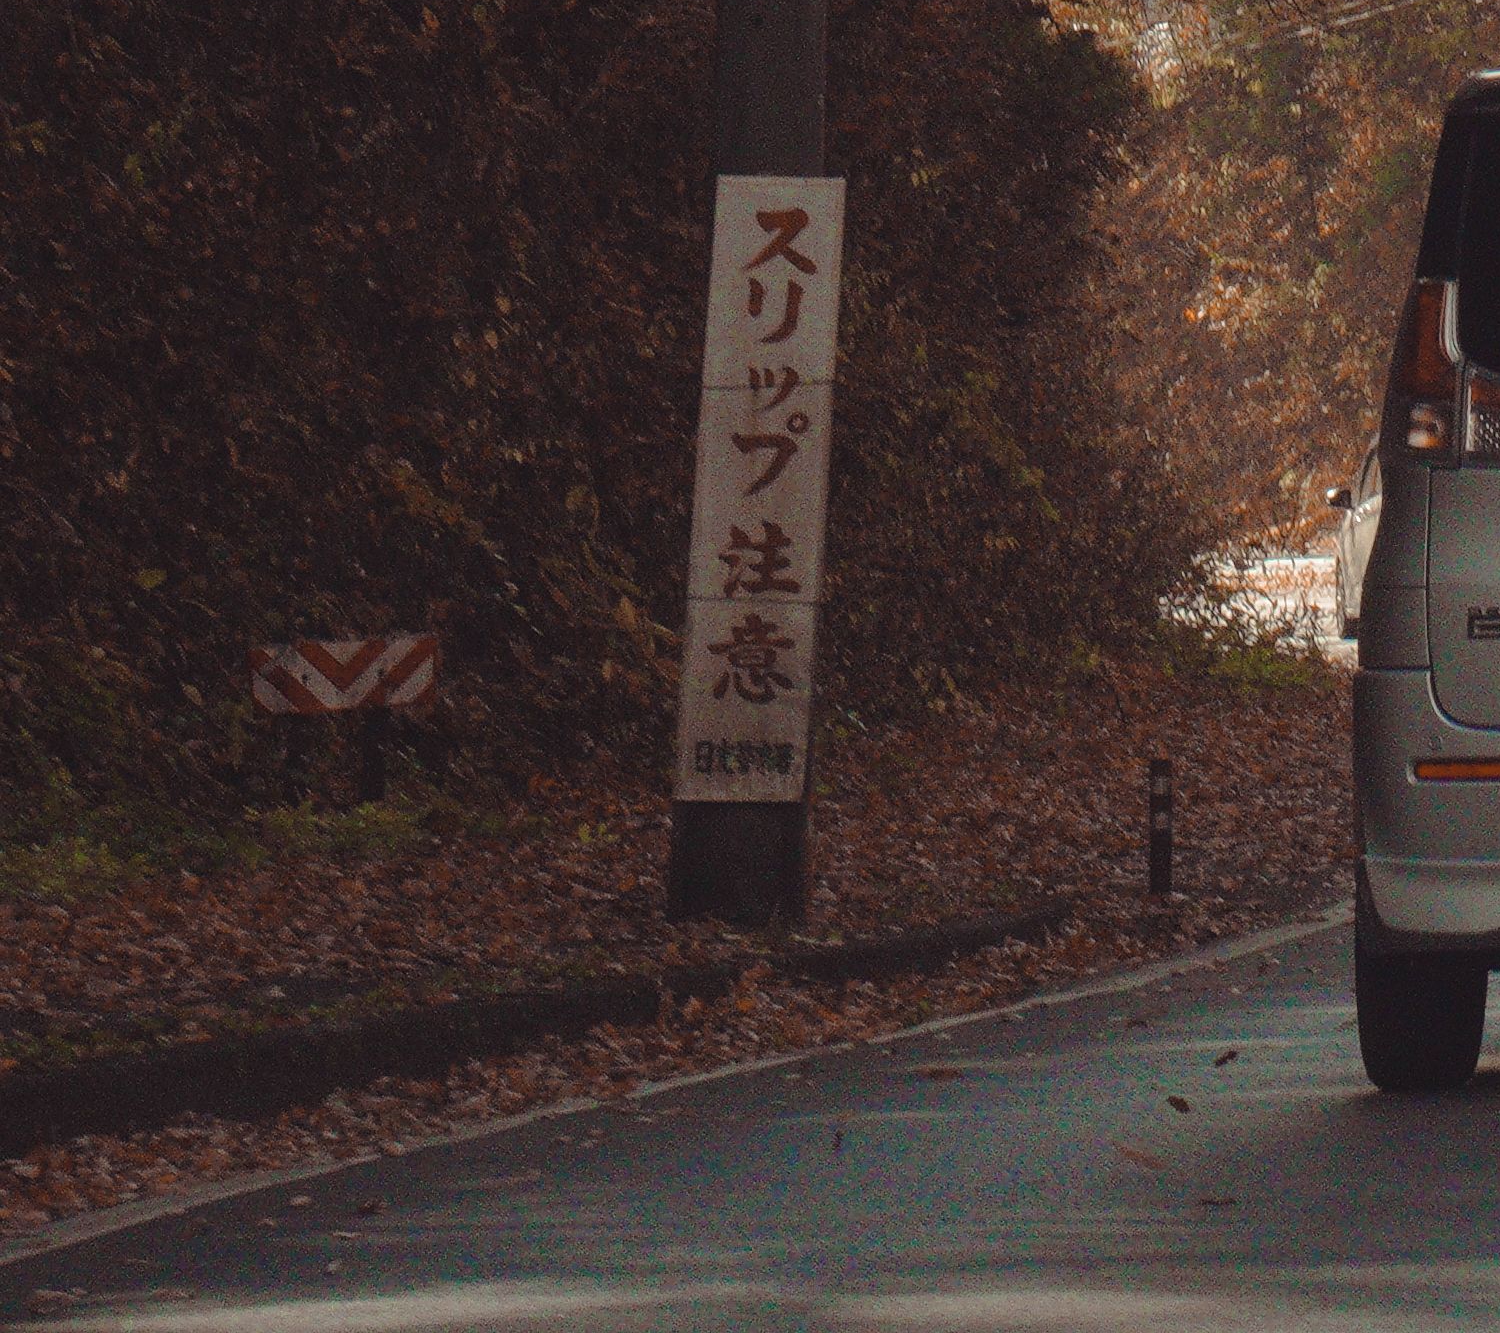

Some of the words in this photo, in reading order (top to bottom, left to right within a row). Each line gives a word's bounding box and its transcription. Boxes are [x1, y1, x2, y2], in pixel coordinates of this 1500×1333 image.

[707, 207, 818, 706] スリップ注意
